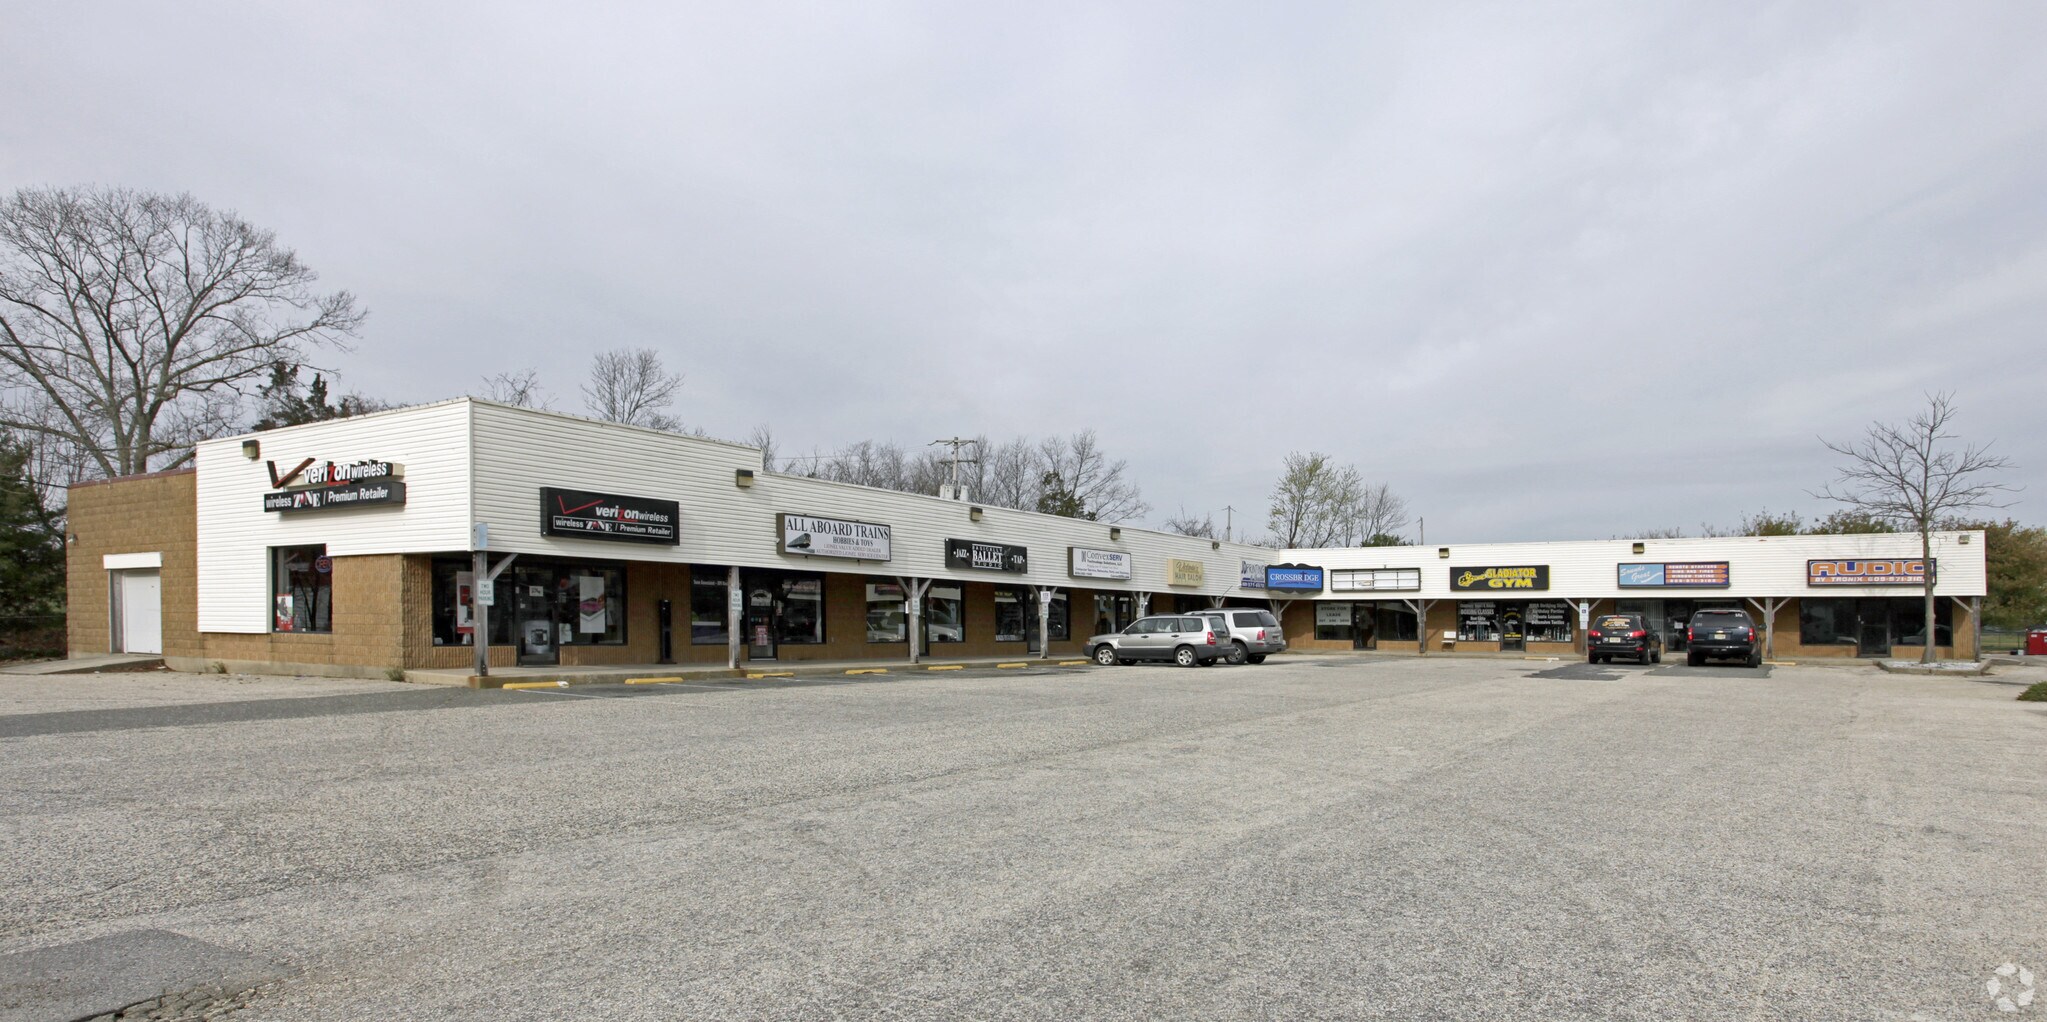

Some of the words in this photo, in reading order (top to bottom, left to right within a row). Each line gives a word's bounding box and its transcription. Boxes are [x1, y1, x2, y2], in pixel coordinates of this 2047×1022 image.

[266, 496, 292, 508] wireless
[293, 492, 320, 508] ZONE
[328, 490, 358, 502] Premium
[360, 487, 388, 500] Retailer
[556, 519, 584, 528] wireless
[586, 520, 612, 532] ZONE
[620, 524, 646, 533] Premium
[648, 526, 671, 535] Retailer
[786, 518, 808, 532] ALL
[810, 520, 852, 536] ABOARD
[854, 524, 889, 540] TRAINS
[833, 536, 855, 545] HOBBIES
[956, 549, 967, 558] JAZZ
[972, 550, 1003, 562] BALLET
[1014, 555, 1023, 563] TAP
[1270, 572, 1319, 581] CROSSBRIDGE
[1485, 568, 1537, 578] GLADIATOR
[1488, 579, 1533, 588] GYM
